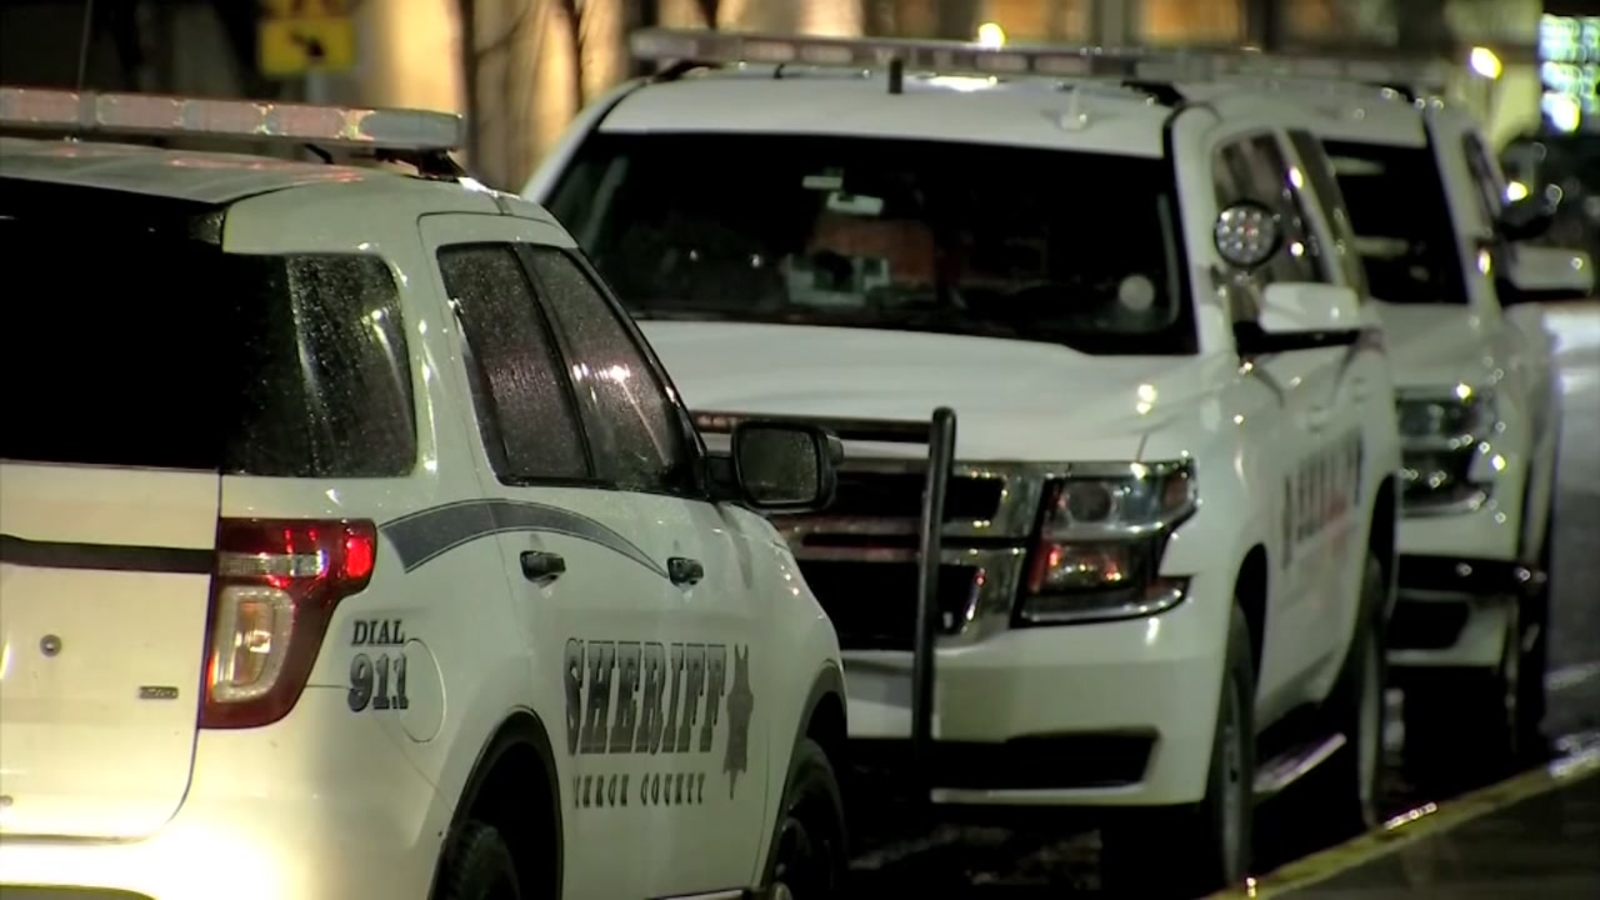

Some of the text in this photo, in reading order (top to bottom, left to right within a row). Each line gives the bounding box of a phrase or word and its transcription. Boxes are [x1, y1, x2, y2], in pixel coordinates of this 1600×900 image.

[351, 620, 405, 645] DIAL
[347, 653, 409, 712] 911
[564, 637, 727, 755] SHERIFF
[640, 772, 706, 806] COUNTY
